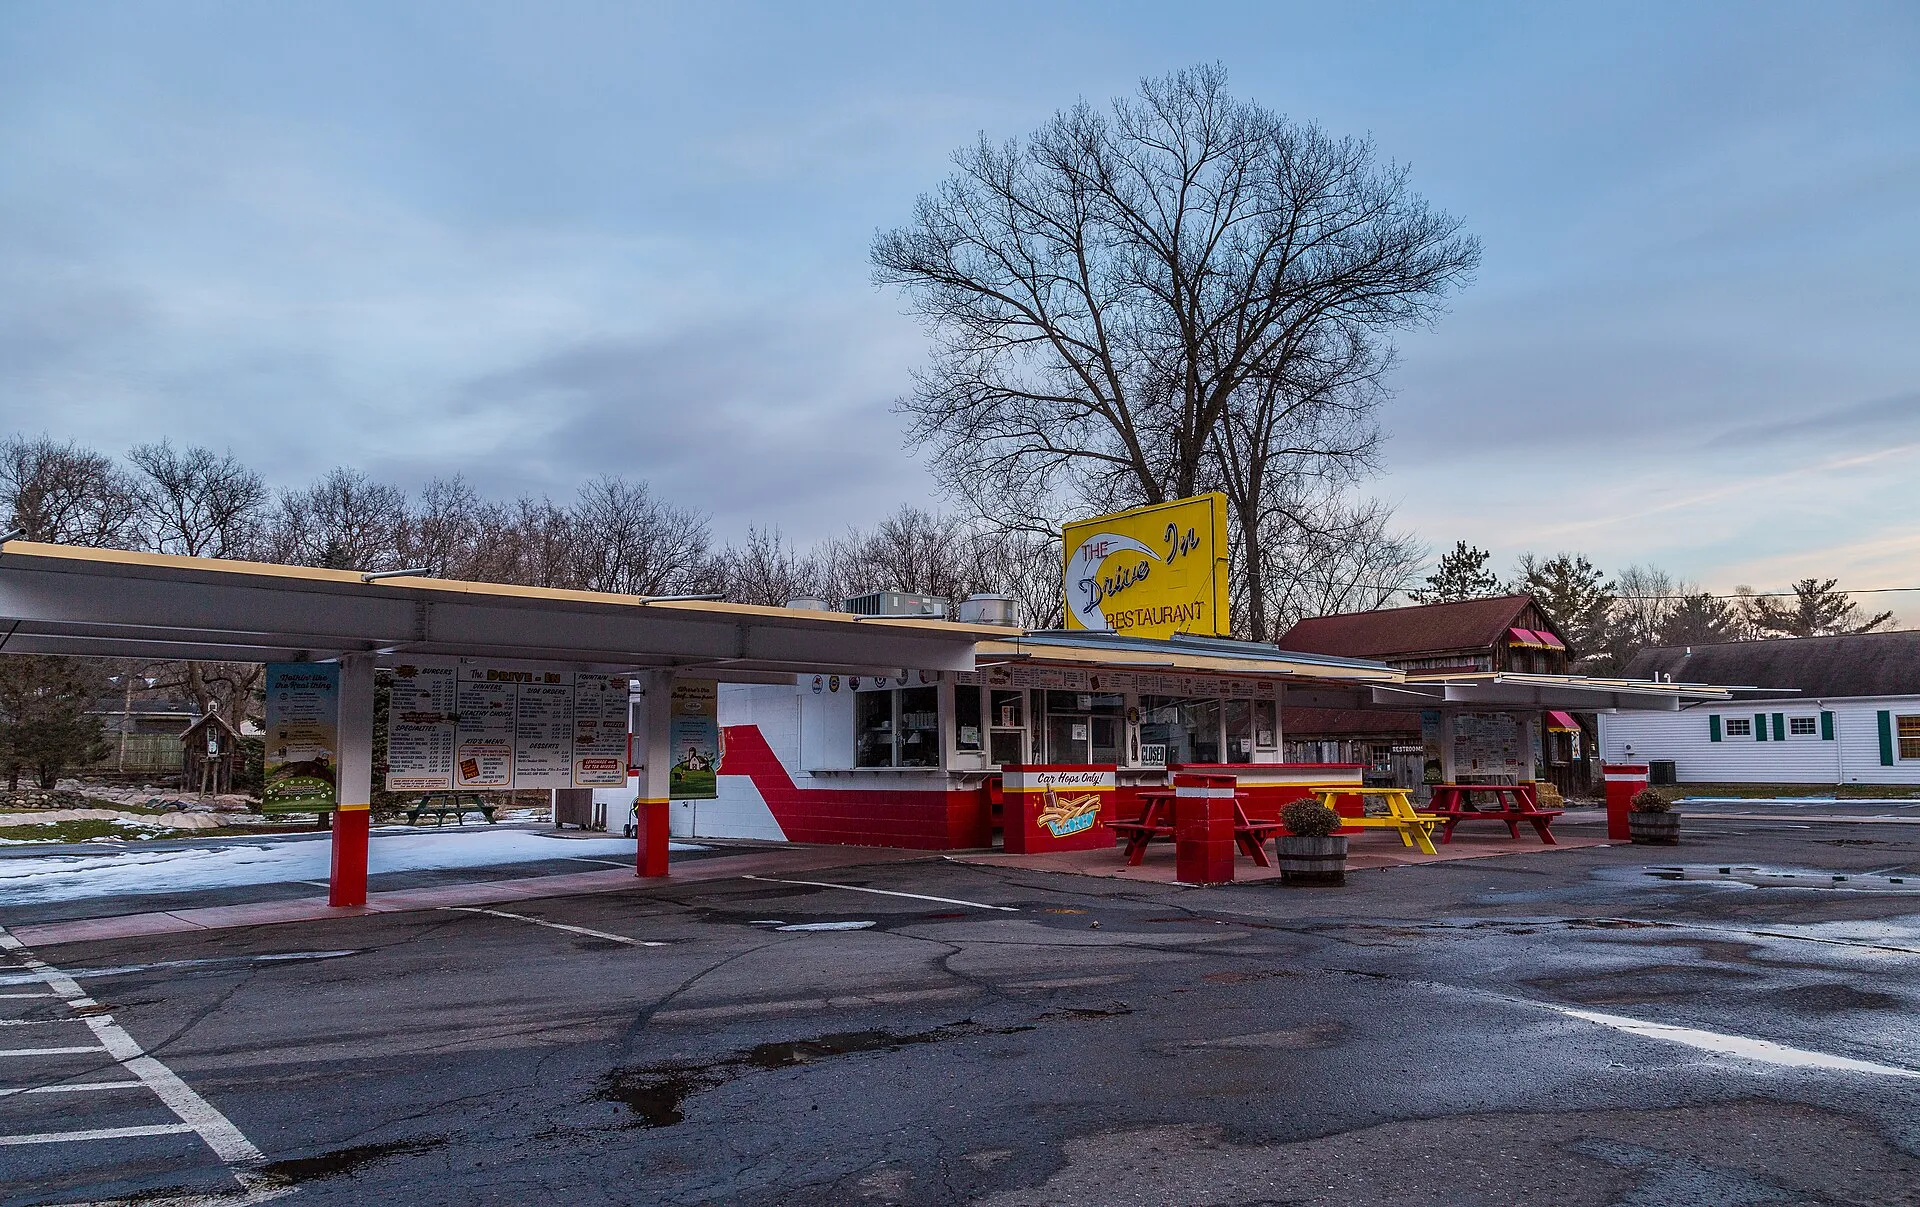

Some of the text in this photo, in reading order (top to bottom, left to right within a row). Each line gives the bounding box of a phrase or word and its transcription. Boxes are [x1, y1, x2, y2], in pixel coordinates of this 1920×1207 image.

[1082, 541, 1109, 561] THE
[1078, 522, 1200, 614] Drive In
[1105, 601, 1205, 630] RESTAURANT
[422, 667, 453, 676] BURGERS
[470, 669, 483, 679] The
[486, 669, 533, 682] DRIVE
[544, 672, 560, 683] IN
[288, 680, 310, 690] Real
[310, 682, 332, 690] thing
[1141, 746, 1164, 762] CLOSED
[1038, 772, 1104, 786] Car Hops Only!
